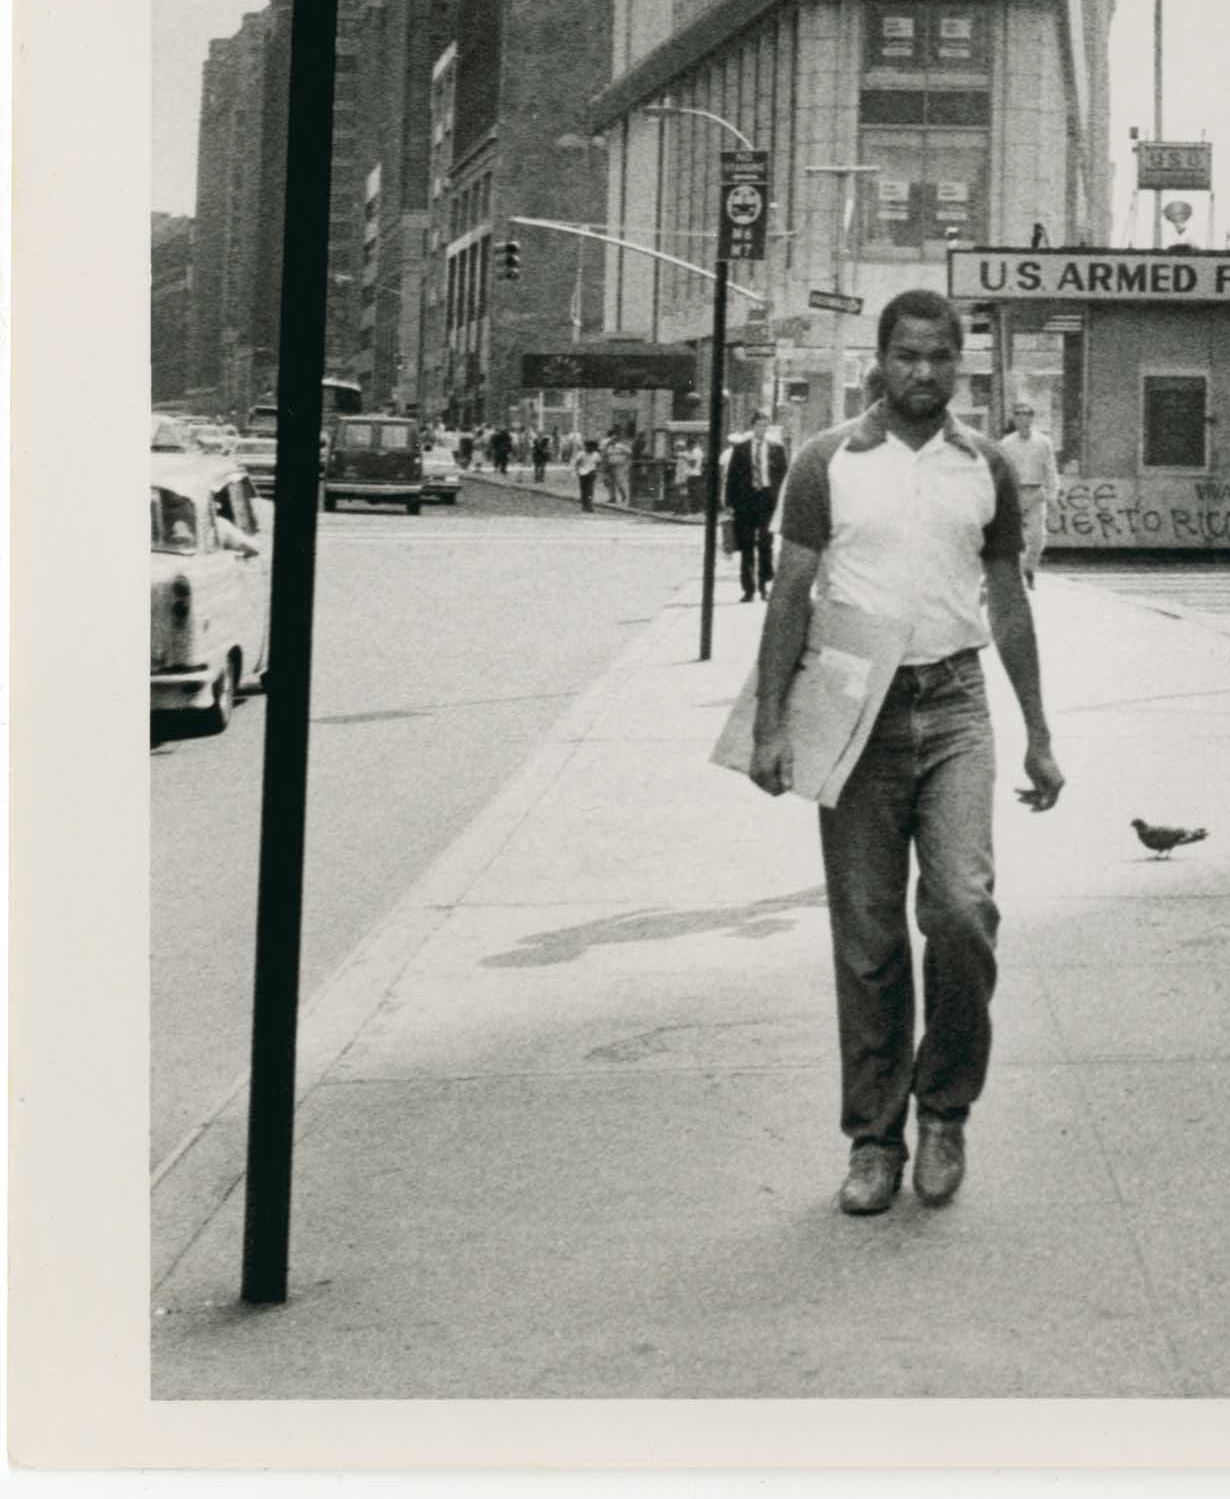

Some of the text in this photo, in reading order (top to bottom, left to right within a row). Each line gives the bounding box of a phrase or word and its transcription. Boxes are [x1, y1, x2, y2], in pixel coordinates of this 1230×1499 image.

[980, 261, 1046, 291] U.S.
[1057, 263, 1198, 294] ARMED
[1046, 504, 1162, 539] UERTO
